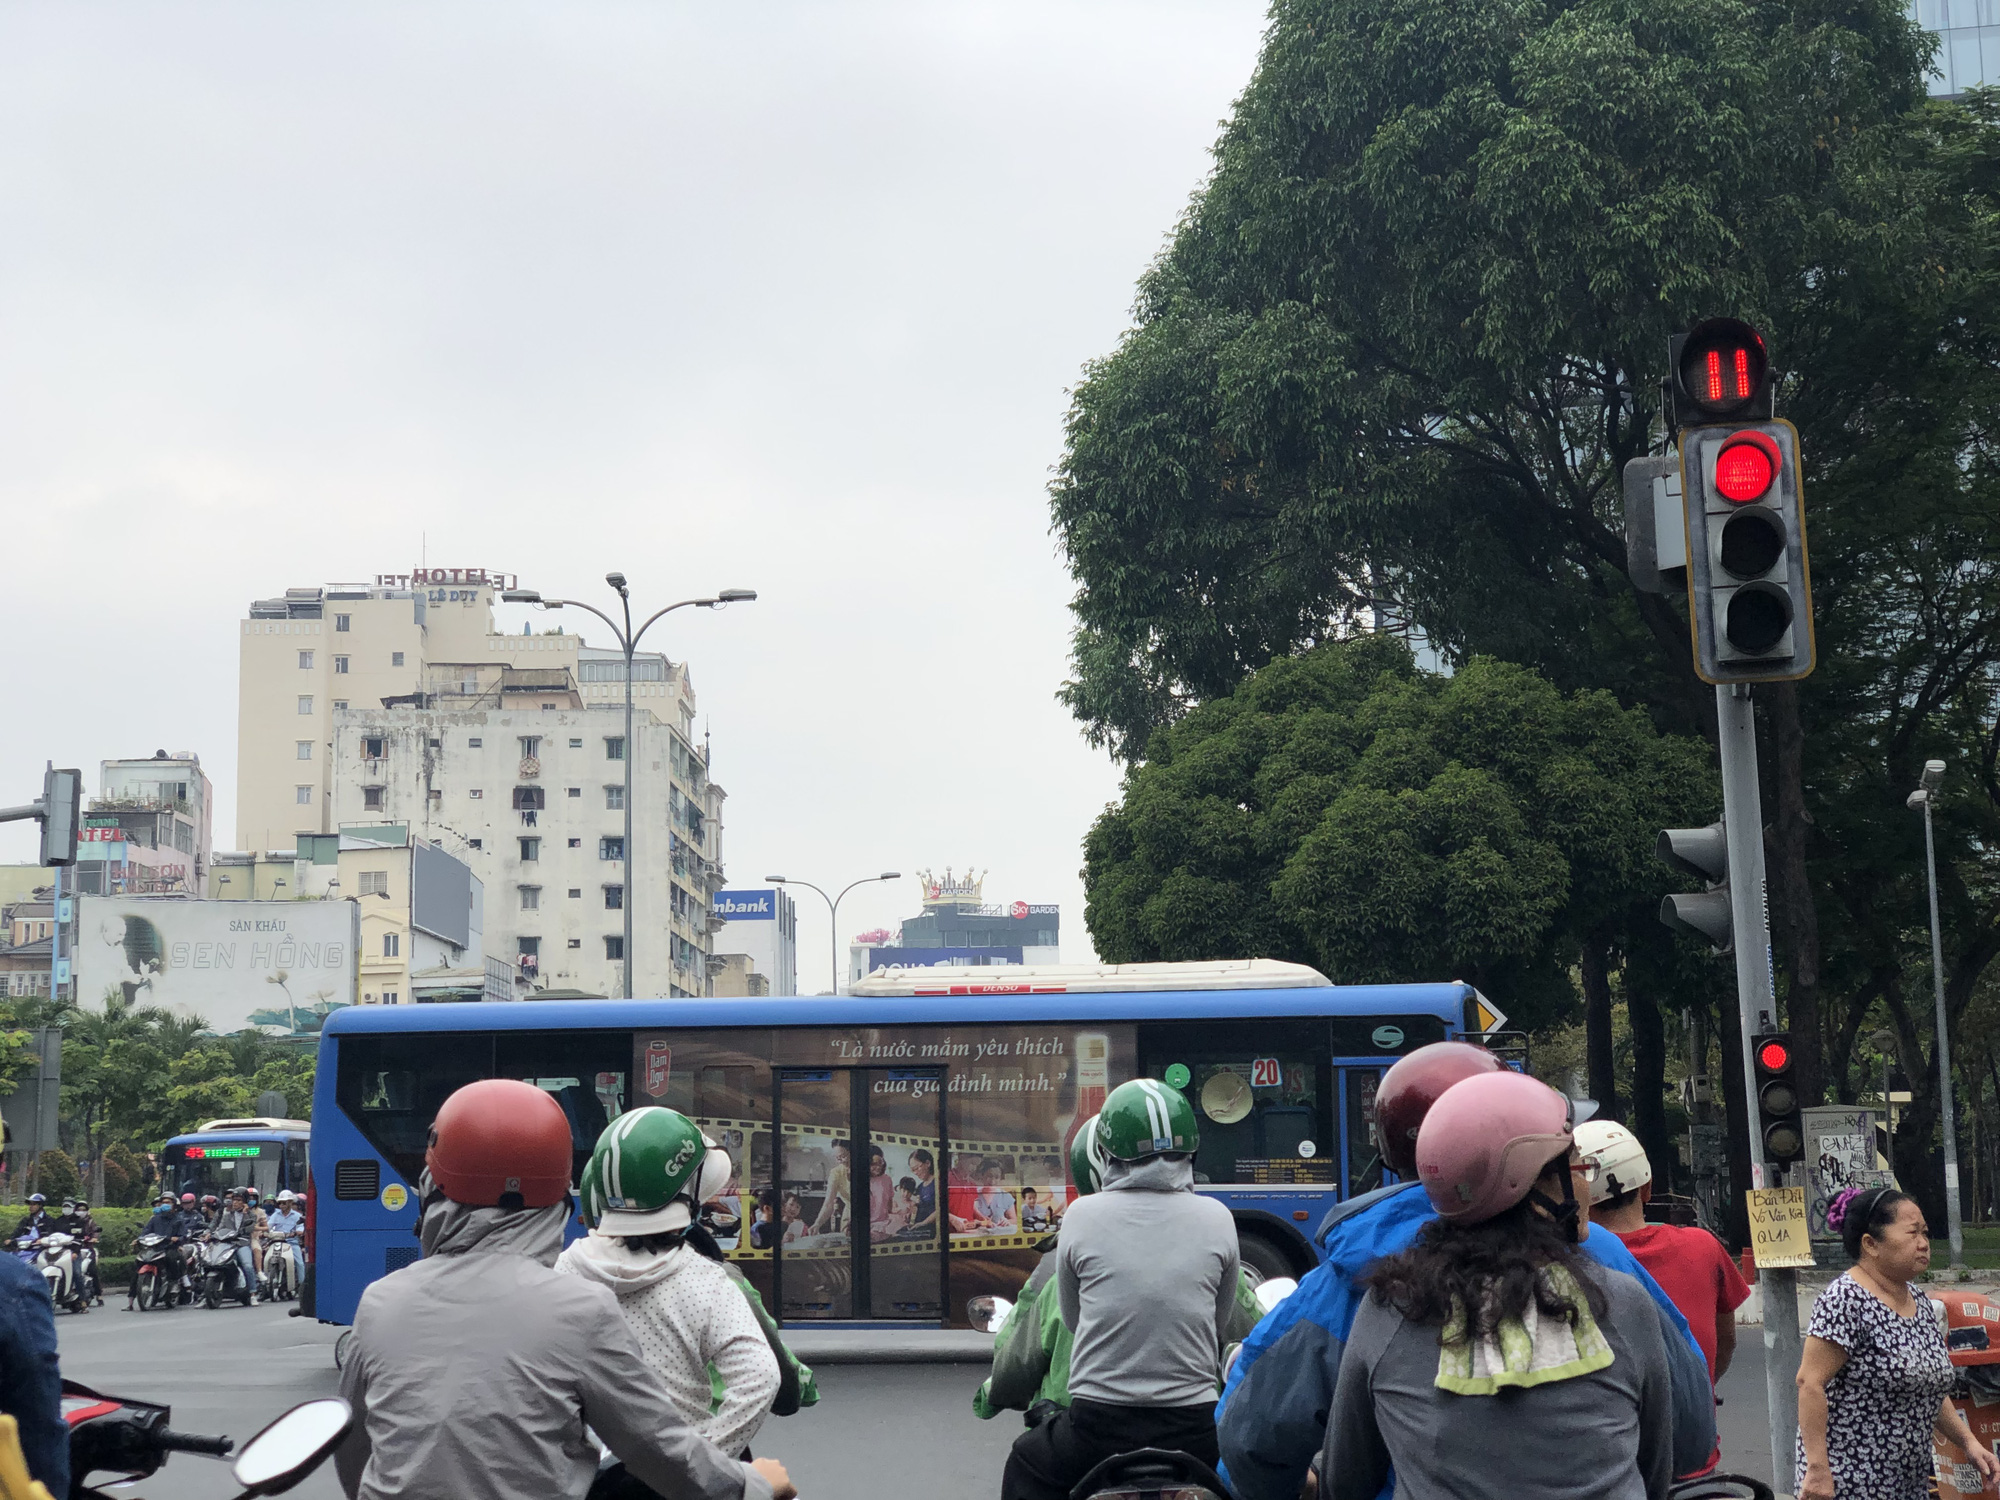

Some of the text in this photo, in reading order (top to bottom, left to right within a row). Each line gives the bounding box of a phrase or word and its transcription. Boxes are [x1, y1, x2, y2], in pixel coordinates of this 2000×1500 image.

[1707, 349, 1749, 399] 11
[413, 568, 492, 584] HOTEL
[940, 888, 975, 896] GARDEN
[1010, 902, 1060, 916] SKY GARDEN
[170, 933, 344, 969] SEN HỒNG
[982, 985, 1019, 993] DENSO
[868, 1040, 917, 1059] nước
[920, 1036, 970, 1058] mắm
[973, 1038, 1009, 1062] yêu
[1014, 1037, 1064, 1056] thích
[1254, 1059, 1279, 1085] 20
[947, 1073, 990, 1093] đình
[665, 1139, 697, 1177] Grab
[1751, 1190, 1779, 1207] Bán
[1752, 1209, 1767, 1223] Võ
[1769, 1207, 1787, 1222] Văn
[1757, 1229, 1791, 1244] QL1A
